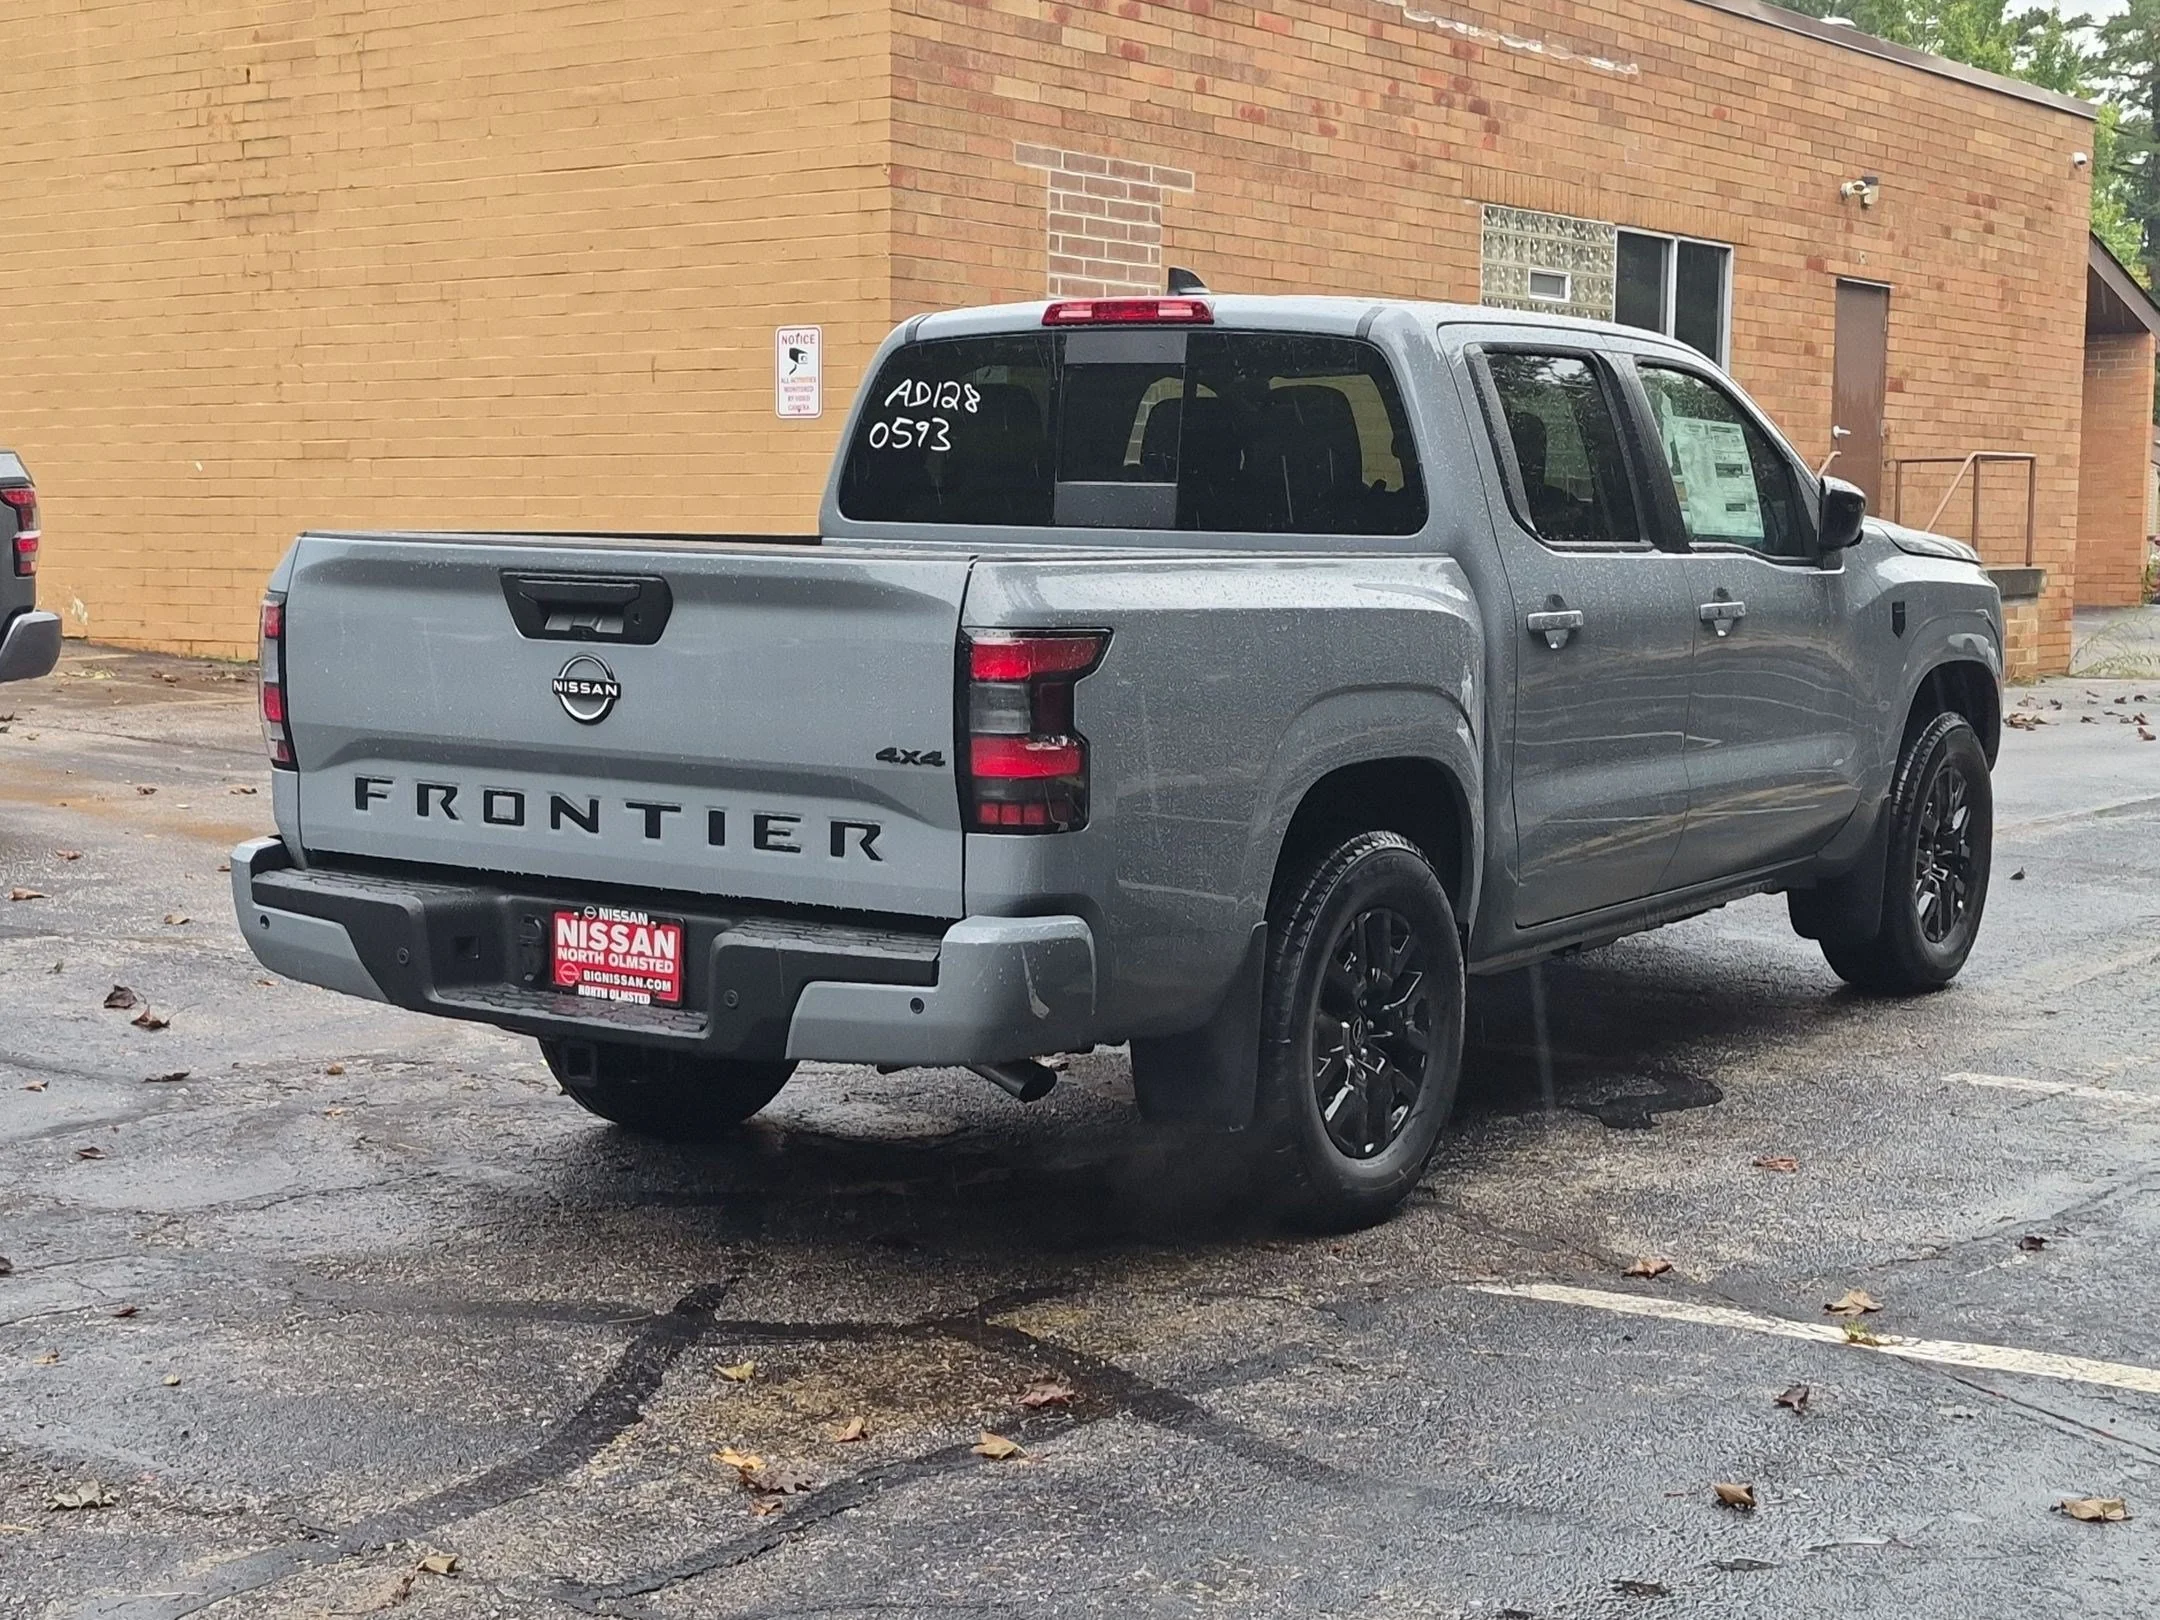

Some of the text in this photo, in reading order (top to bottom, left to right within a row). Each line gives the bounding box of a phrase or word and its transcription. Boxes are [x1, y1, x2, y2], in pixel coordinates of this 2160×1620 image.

[781, 333, 816, 345] NOTICE
[884, 378, 981, 414] AD128
[869, 416, 952, 452] 0593
[553, 680, 618, 697] NISSAN
[354, 775, 884, 861] FRONTIER
[598, 907, 648, 925] NISSAN
[557, 918, 676, 959] NISSAN
[557, 947, 675, 974] NORTH OLMSTED
[578, 984, 651, 1005] NORTH OLMSTED
